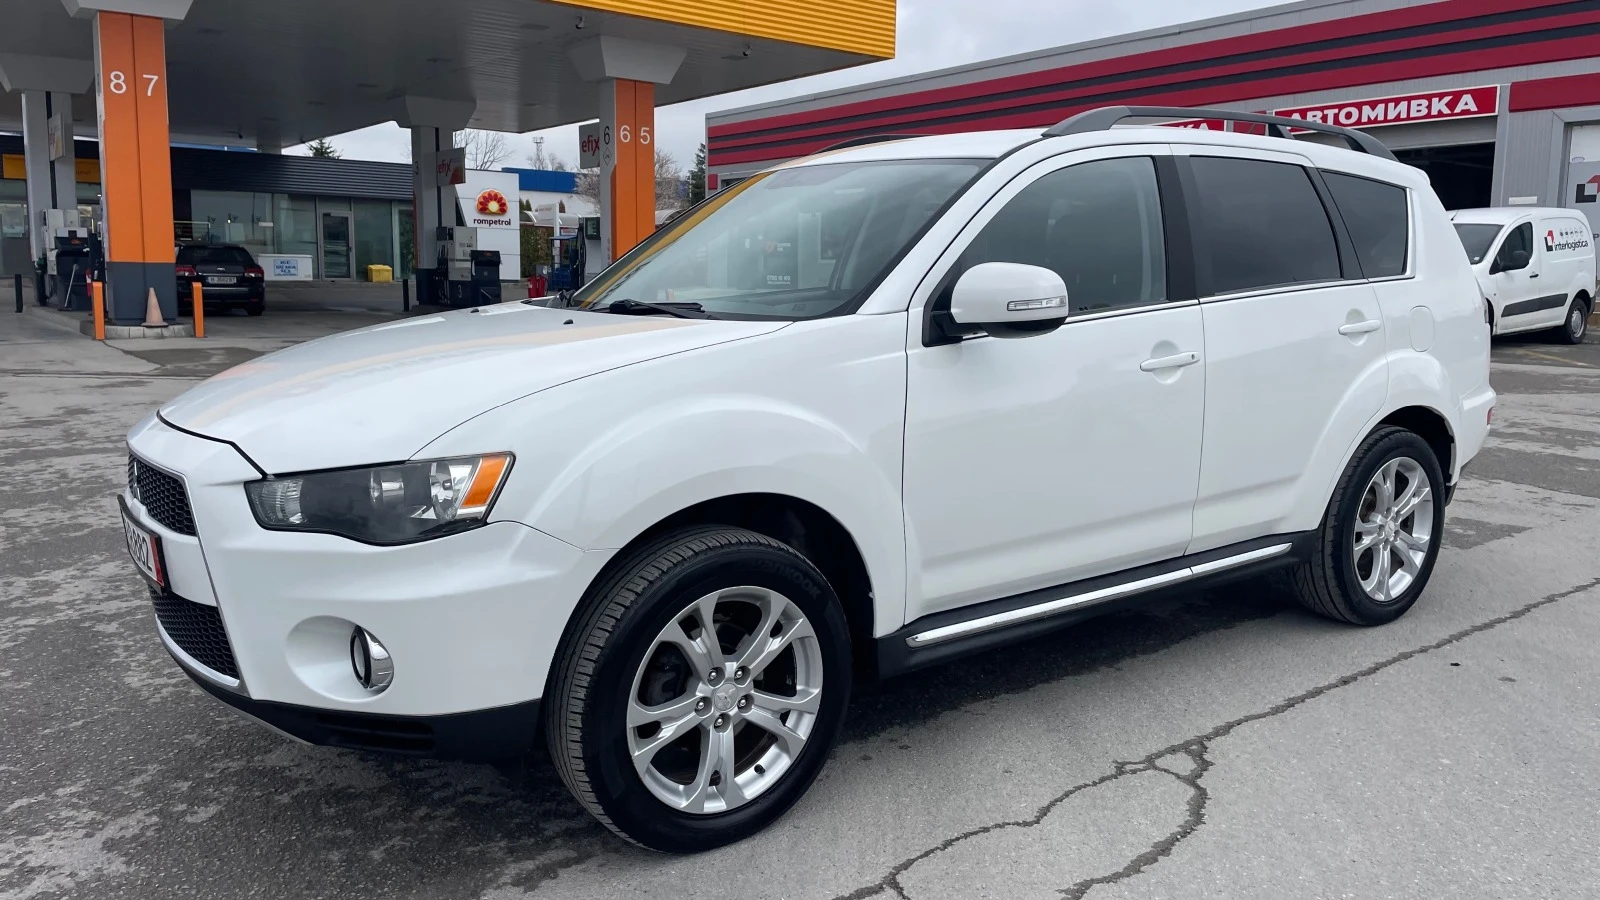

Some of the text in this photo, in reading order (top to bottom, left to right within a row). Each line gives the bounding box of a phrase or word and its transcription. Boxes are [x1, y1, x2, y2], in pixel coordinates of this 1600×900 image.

[109, 70, 127, 94] 8
[142, 74, 159, 97] 7
[603, 125, 611, 145] 6
[620, 124, 651, 145] 6 5
[581, 135, 600, 156] efix
[473, 218, 512, 227] rompetrol
[1553, 239, 1589, 251] interlogistica
